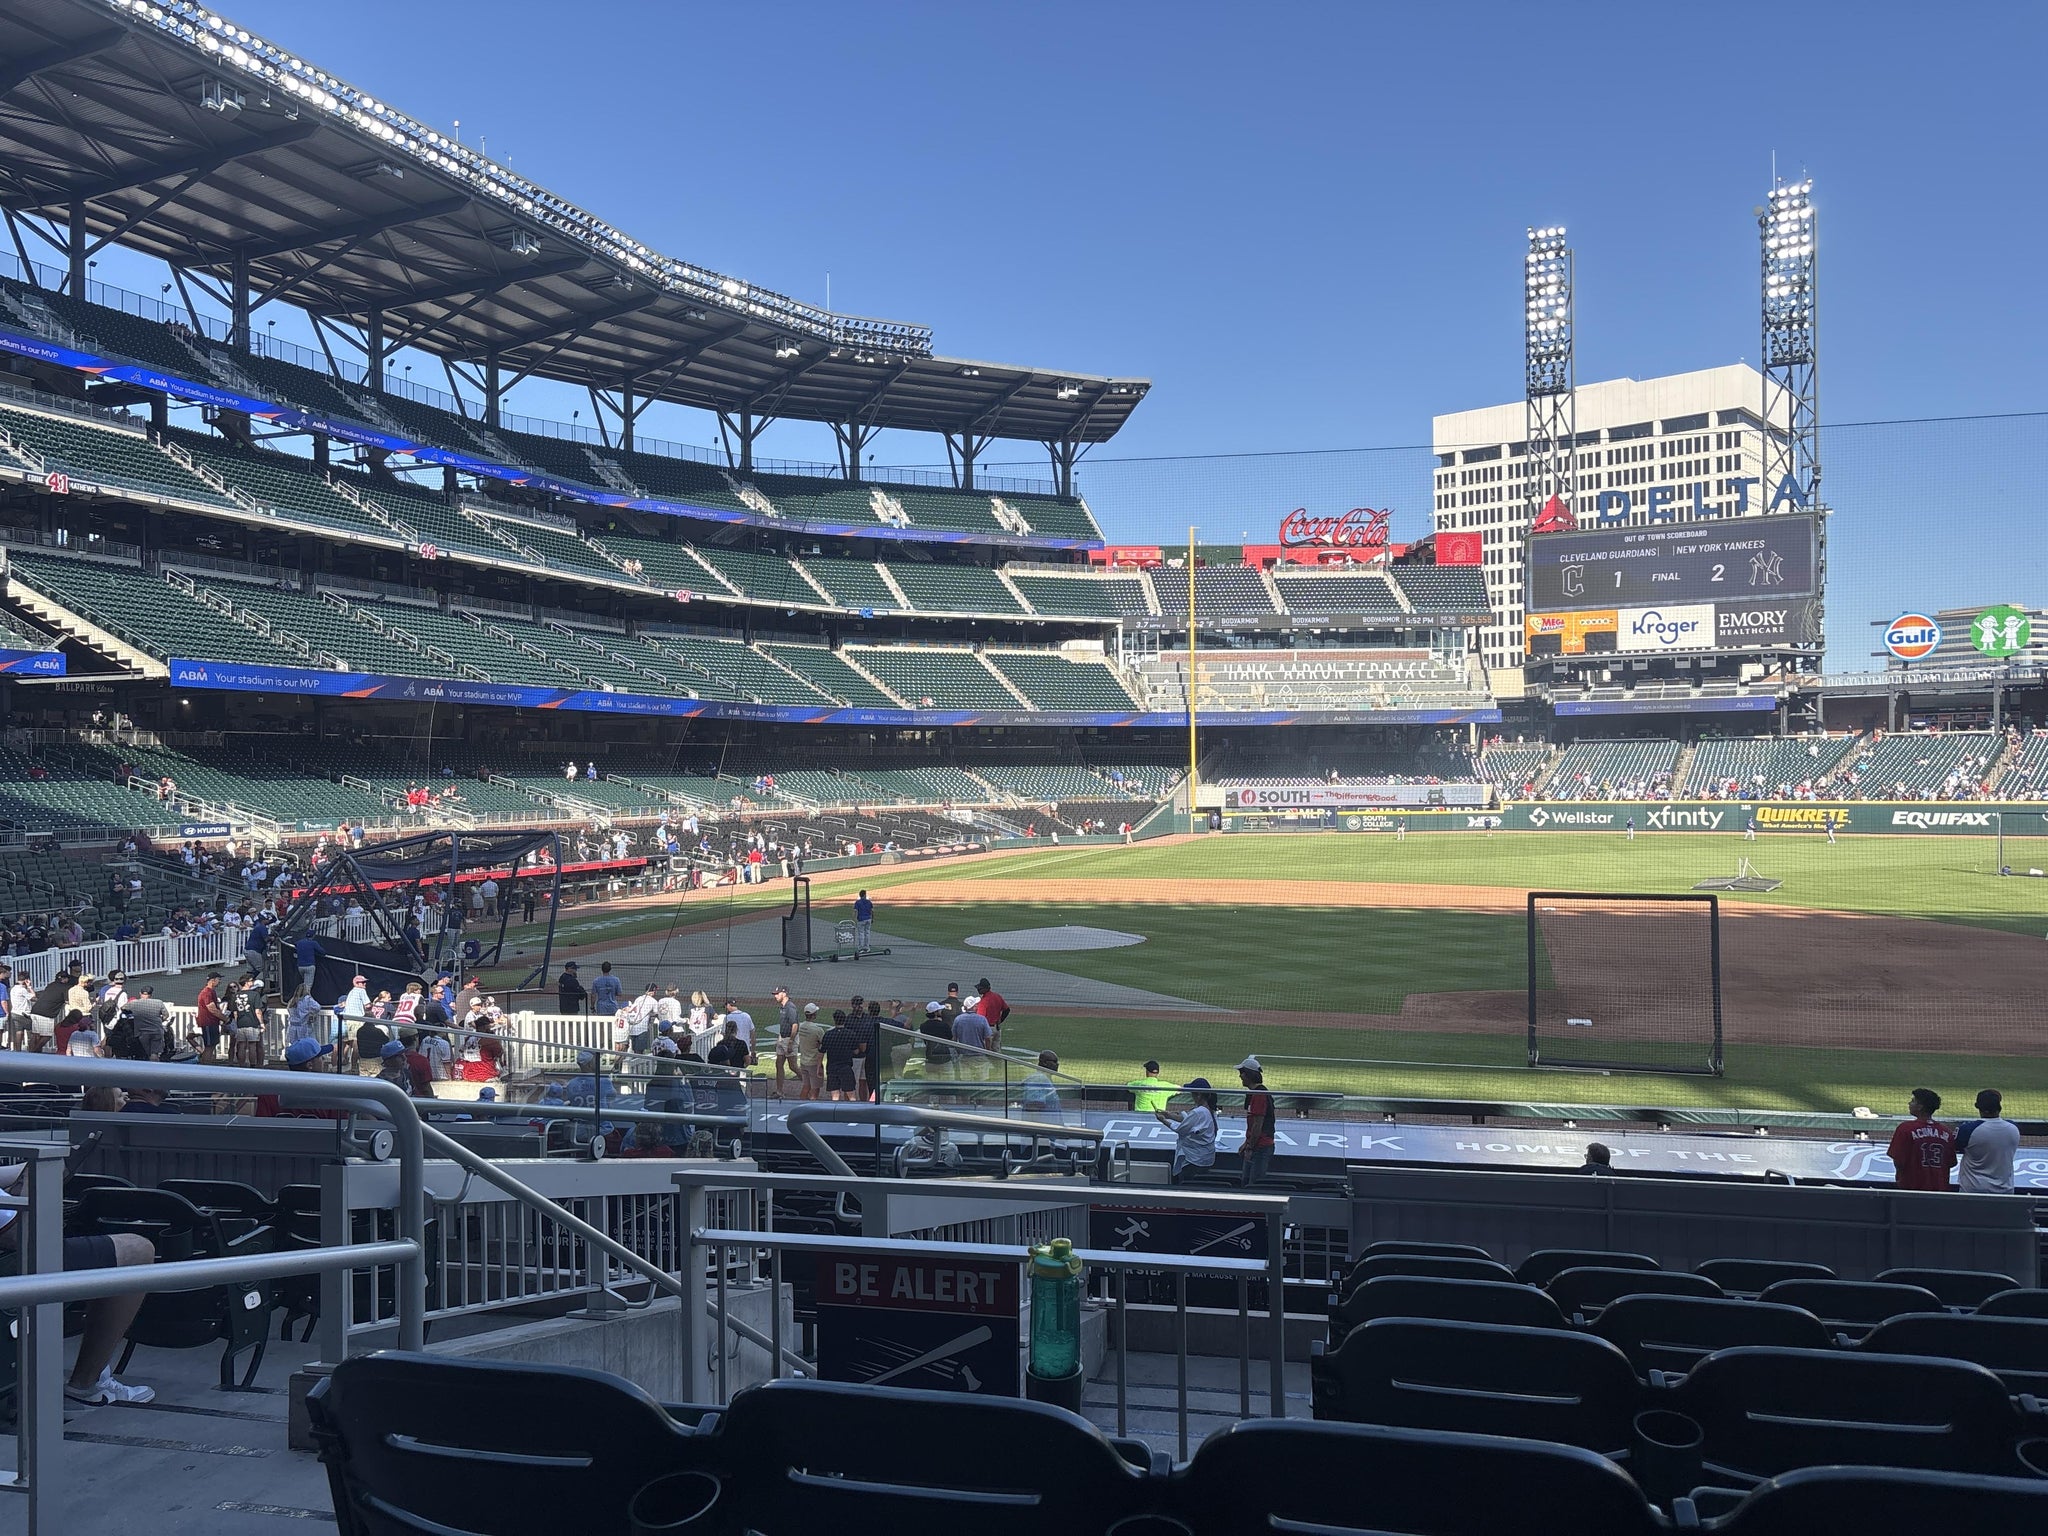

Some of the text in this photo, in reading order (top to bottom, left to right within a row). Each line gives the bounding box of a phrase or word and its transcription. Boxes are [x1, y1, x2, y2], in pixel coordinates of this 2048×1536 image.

[41, 349, 58, 359] MVP
[149, 378, 168, 388] ABM
[226, 398, 240, 406] MVP
[312, 420, 328, 430] ABM
[27, 474, 43, 483] EDDIE
[46, 471, 69, 494] 41
[69, 481, 97, 494] MATHEWS
[1599, 473, 1809, 523] DELTA
[1624, 535, 1637, 543] OUT
[1647, 533, 1665, 541] TOWN
[1666, 530, 1708, 540] SCOREBOARD
[419, 543, 437, 560] 44
[1676, 540, 1765, 554] NEW YORK YANKEES
[1560, 548, 1657, 563] CLEVELAND GUARDIANS
[1614, 571, 1622, 588] 1
[1652, 572, 1681, 582] FINAL
[1711, 564, 1725, 581] 2
[676, 590, 691, 603] 47
[1292, 616, 1330, 624] BODYARMOR
[1406, 617, 1421, 625] 5:52
[1542, 618, 1565, 626] MEGA
[1719, 610, 1787, 627] EMORY
[1633, 611, 1699, 644] Kroger
[1719, 626, 1785, 636] HEALTHCARE
[1887, 628, 1936, 644] Gulf
[33, 659, 60, 669] ABM
[1223, 661, 1439, 681] HANK AARON TERRACE
[178, 669, 320, 688] ABM Your stadium is our MVP
[55, 682, 95, 692] BALLPARK
[423, 687, 522, 701] ABM Your stadium is our MVP
[597, 699, 612, 707] ABM
[1260, 791, 1310, 803] SOUTH
[1552, 811, 1614, 824] Wellstar
[1646, 805, 1724, 829] xfinity
[1892, 810, 1990, 829] EQUIFAX
[197, 826, 228, 834] HYUNDAI
[1455, 1141, 1581, 1156] HOME
[1667, 1149, 1758, 1163] THE
[1920, 1142, 1944, 1168] 13
[835, 1262, 1000, 1305] BE ALERT
